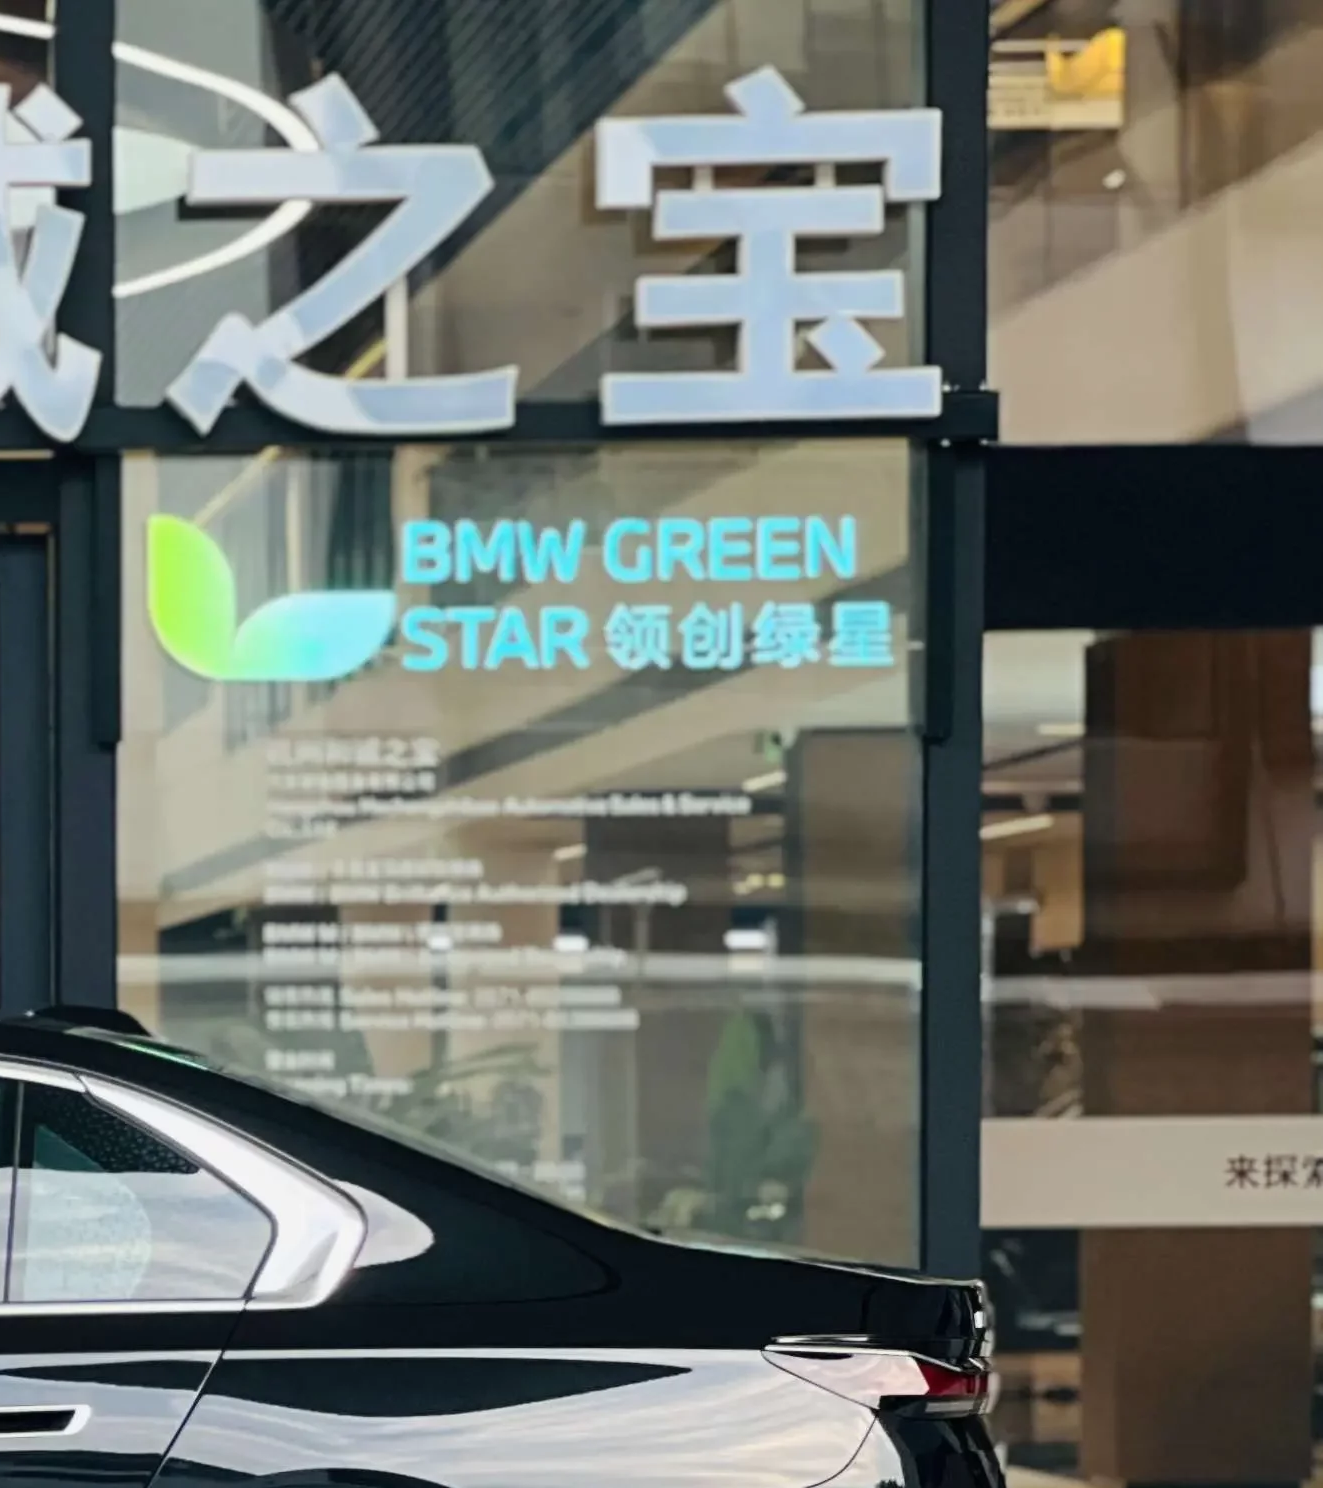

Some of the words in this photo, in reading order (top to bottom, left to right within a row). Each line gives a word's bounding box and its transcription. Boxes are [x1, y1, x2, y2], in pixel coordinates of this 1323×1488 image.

[401, 518, 586, 584] BMW
[603, 515, 857, 582] GREEN
[401, 605, 591, 671] STAR
[604, 600, 895, 671] 领创绿星
